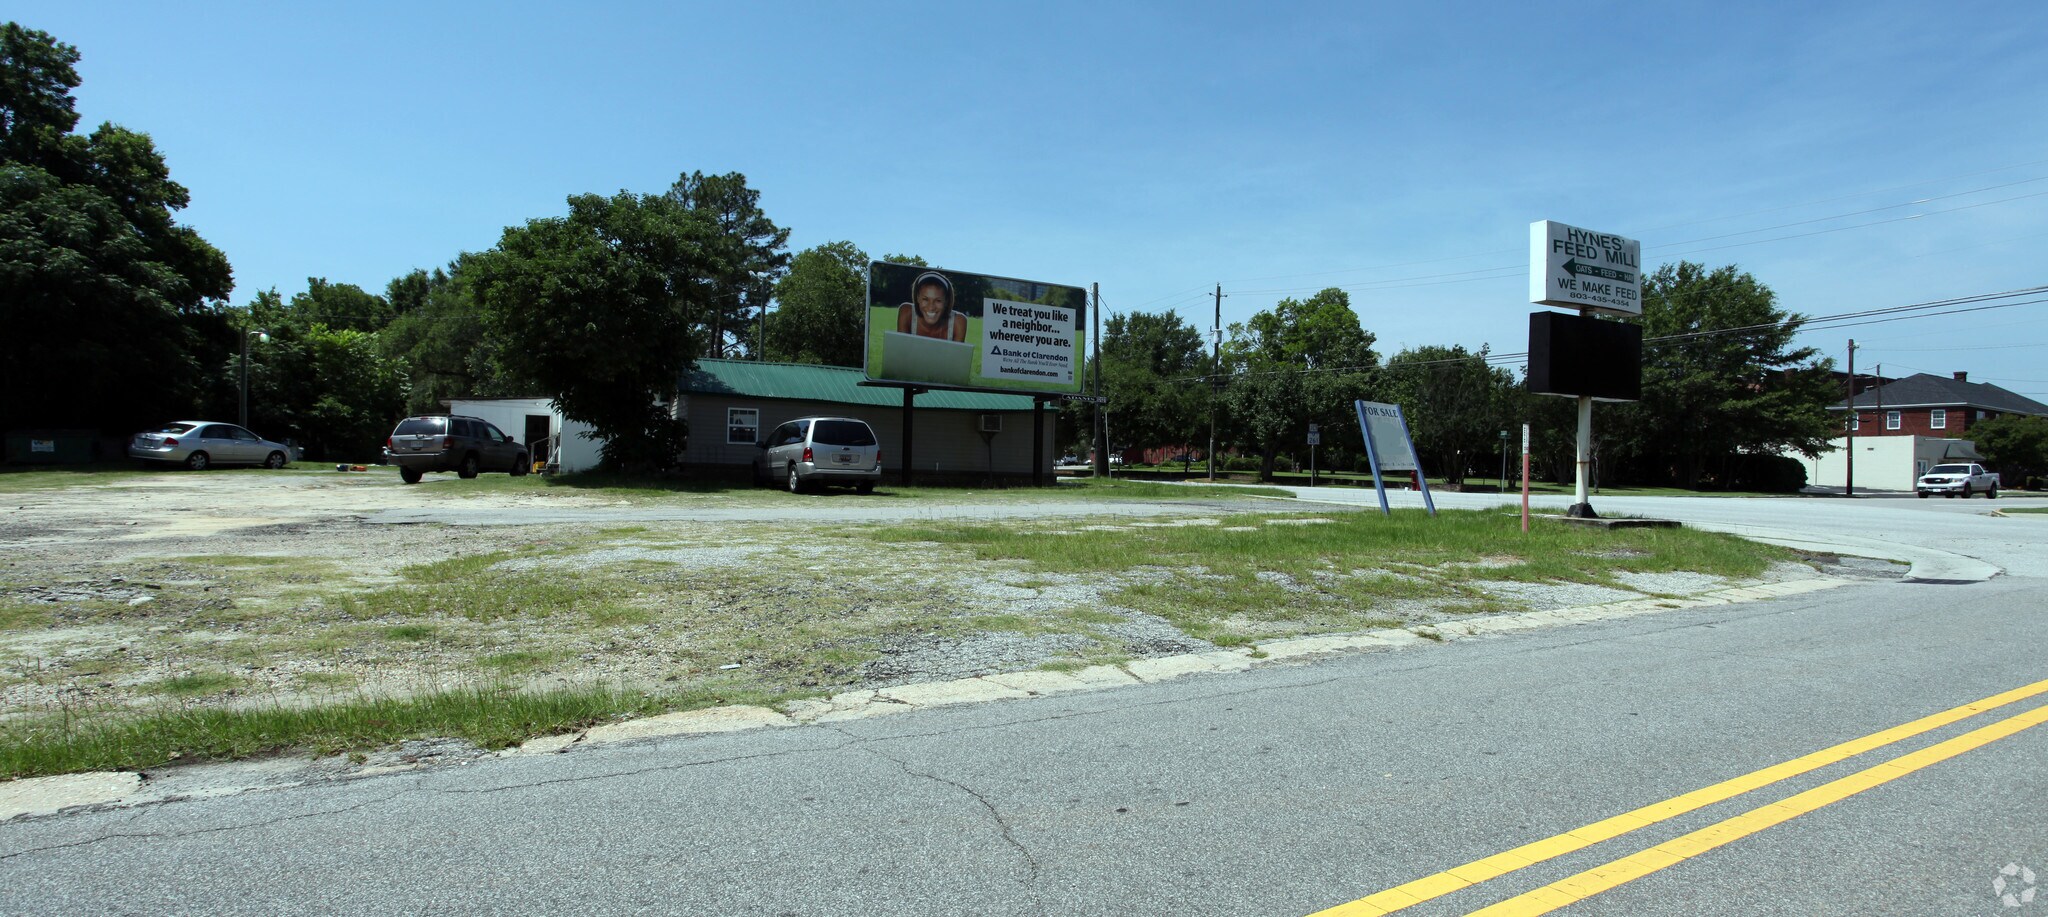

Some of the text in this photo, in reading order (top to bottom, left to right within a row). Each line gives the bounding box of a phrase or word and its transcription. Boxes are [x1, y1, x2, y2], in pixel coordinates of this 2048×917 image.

[1568, 228, 1624, 251] HYNES'
[1554, 240, 1638, 268] FEED MILL
[1576, 264, 1592, 274] OATS
[1601, 269, 1616, 278] FEED
[1558, 278, 1637, 300] WE MAKE FEED
[1570, 292, 1630, 307] 803-435-4354
[992, 303, 1068, 322] We treat you like
[1010, 320, 1060, 333] neighbor...
[990, 329, 1071, 347] wherever you are.
[1003, 349, 1021, 357] Bank
[1032, 352, 1068, 362] Clarendon
[1000, 366, 1058, 377] bankofclarendon.com
[1363, 407, 1398, 418] FOR SALE
